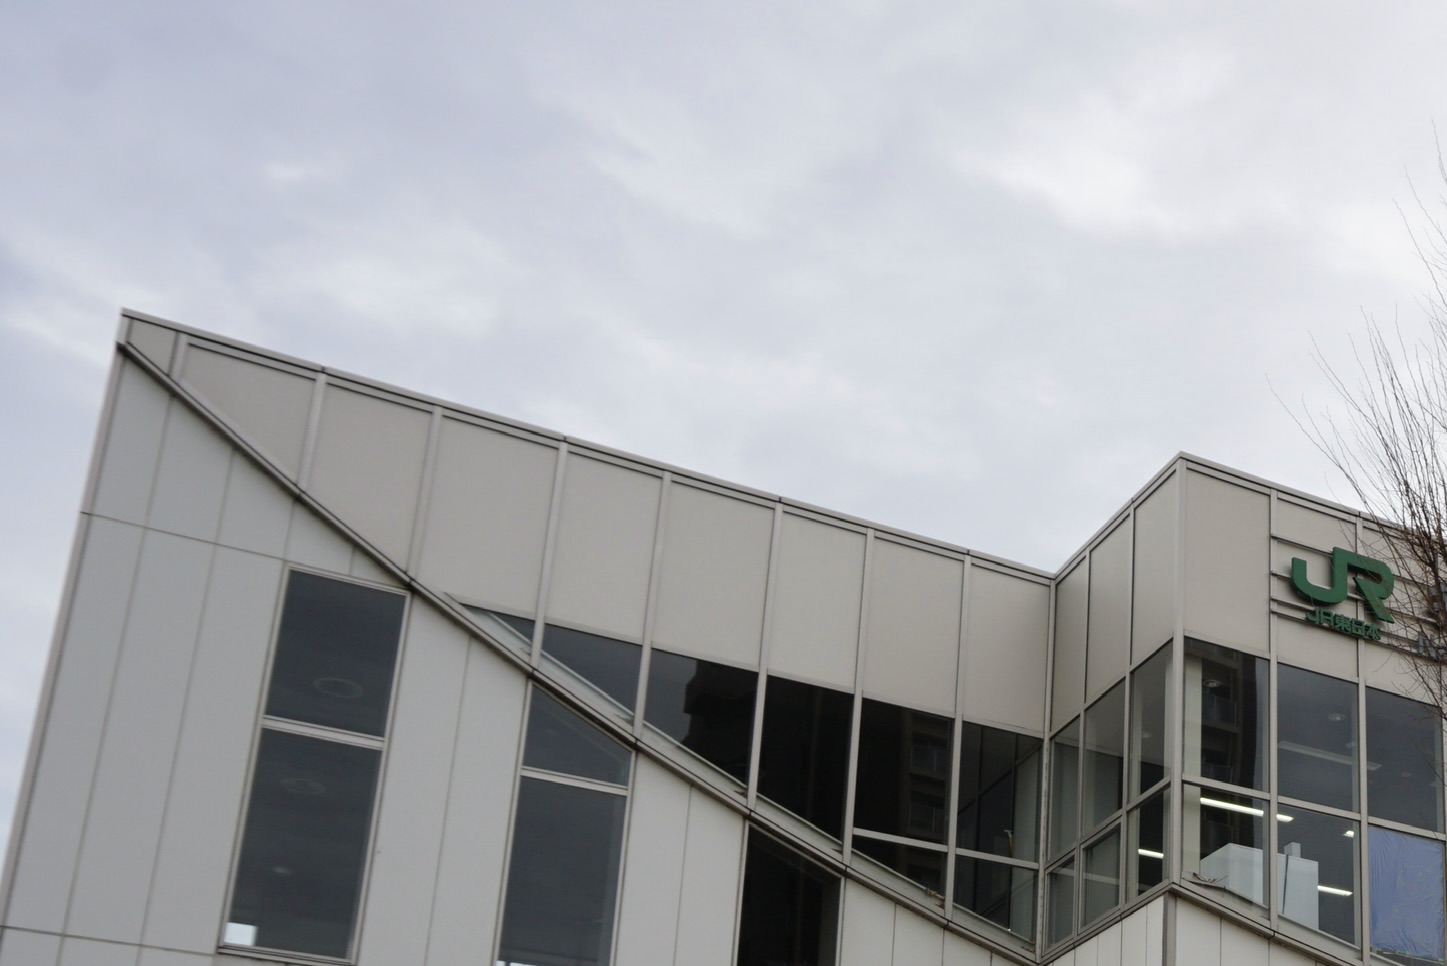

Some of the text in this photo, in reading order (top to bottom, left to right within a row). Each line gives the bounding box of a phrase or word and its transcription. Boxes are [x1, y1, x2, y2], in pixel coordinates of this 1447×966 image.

[1291, 547, 1395, 623] JR
[1305, 606, 1381, 640] JR東日本
